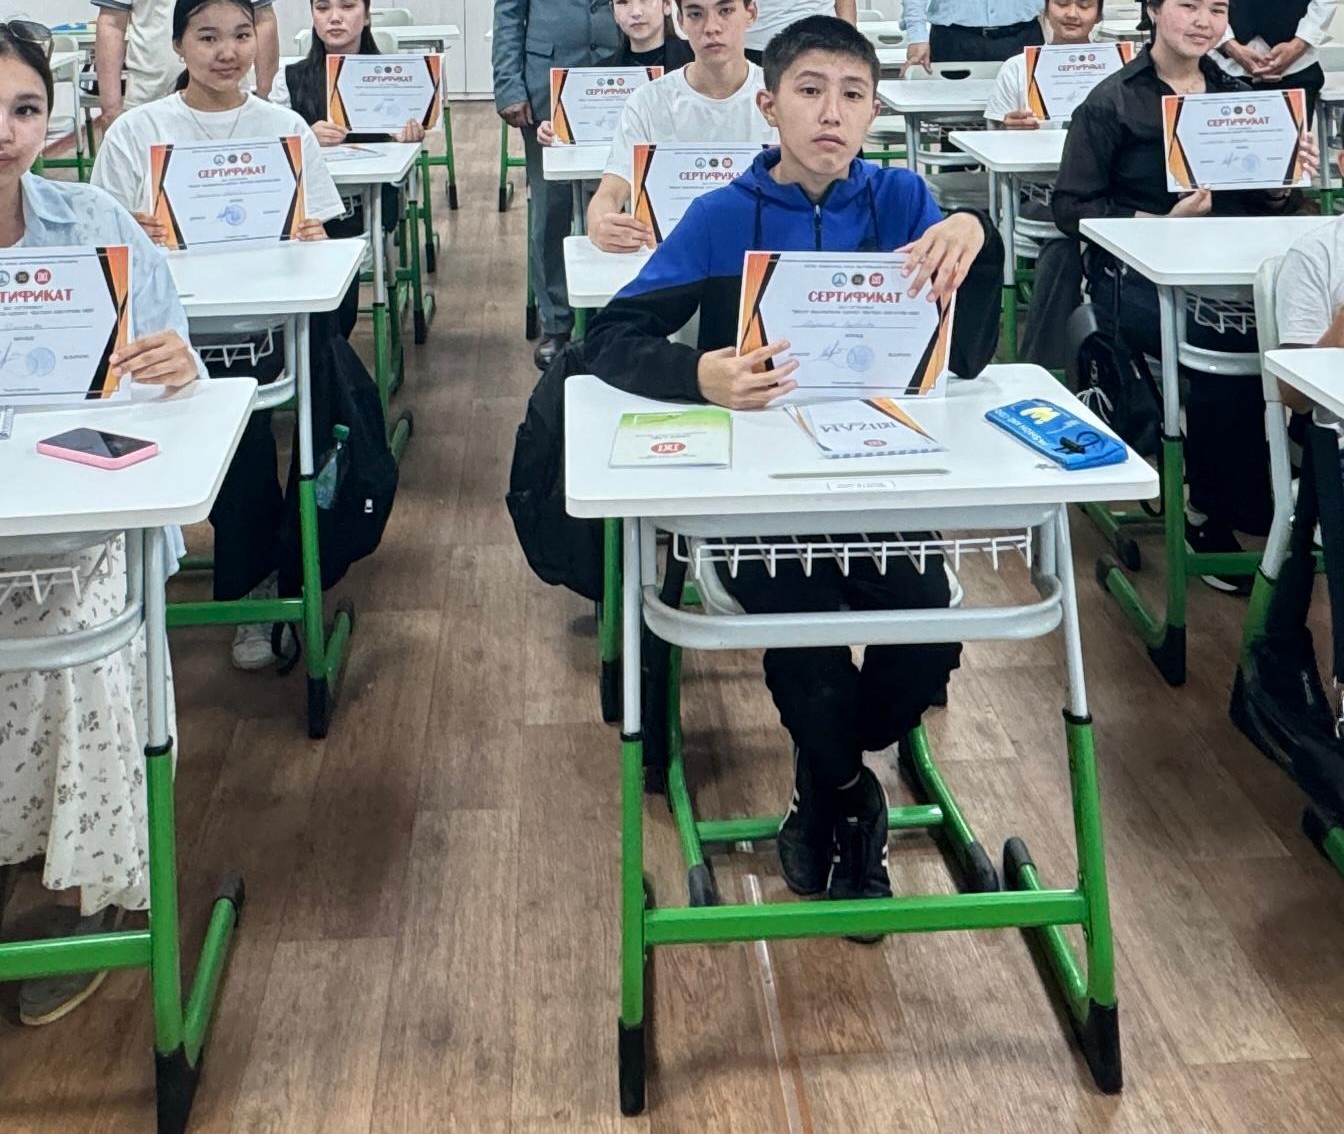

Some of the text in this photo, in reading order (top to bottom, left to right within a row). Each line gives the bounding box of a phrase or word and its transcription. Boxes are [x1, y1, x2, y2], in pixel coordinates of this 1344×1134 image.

[1207, 116, 1270, 128] СЕРТИФИКАТ
[198, 165, 267, 179] СЕРТИФИКАТ
[679, 171, 743, 181] СЕРТИФИКА
[808, 290, 904, 303] СЕРТИФИКАТ
